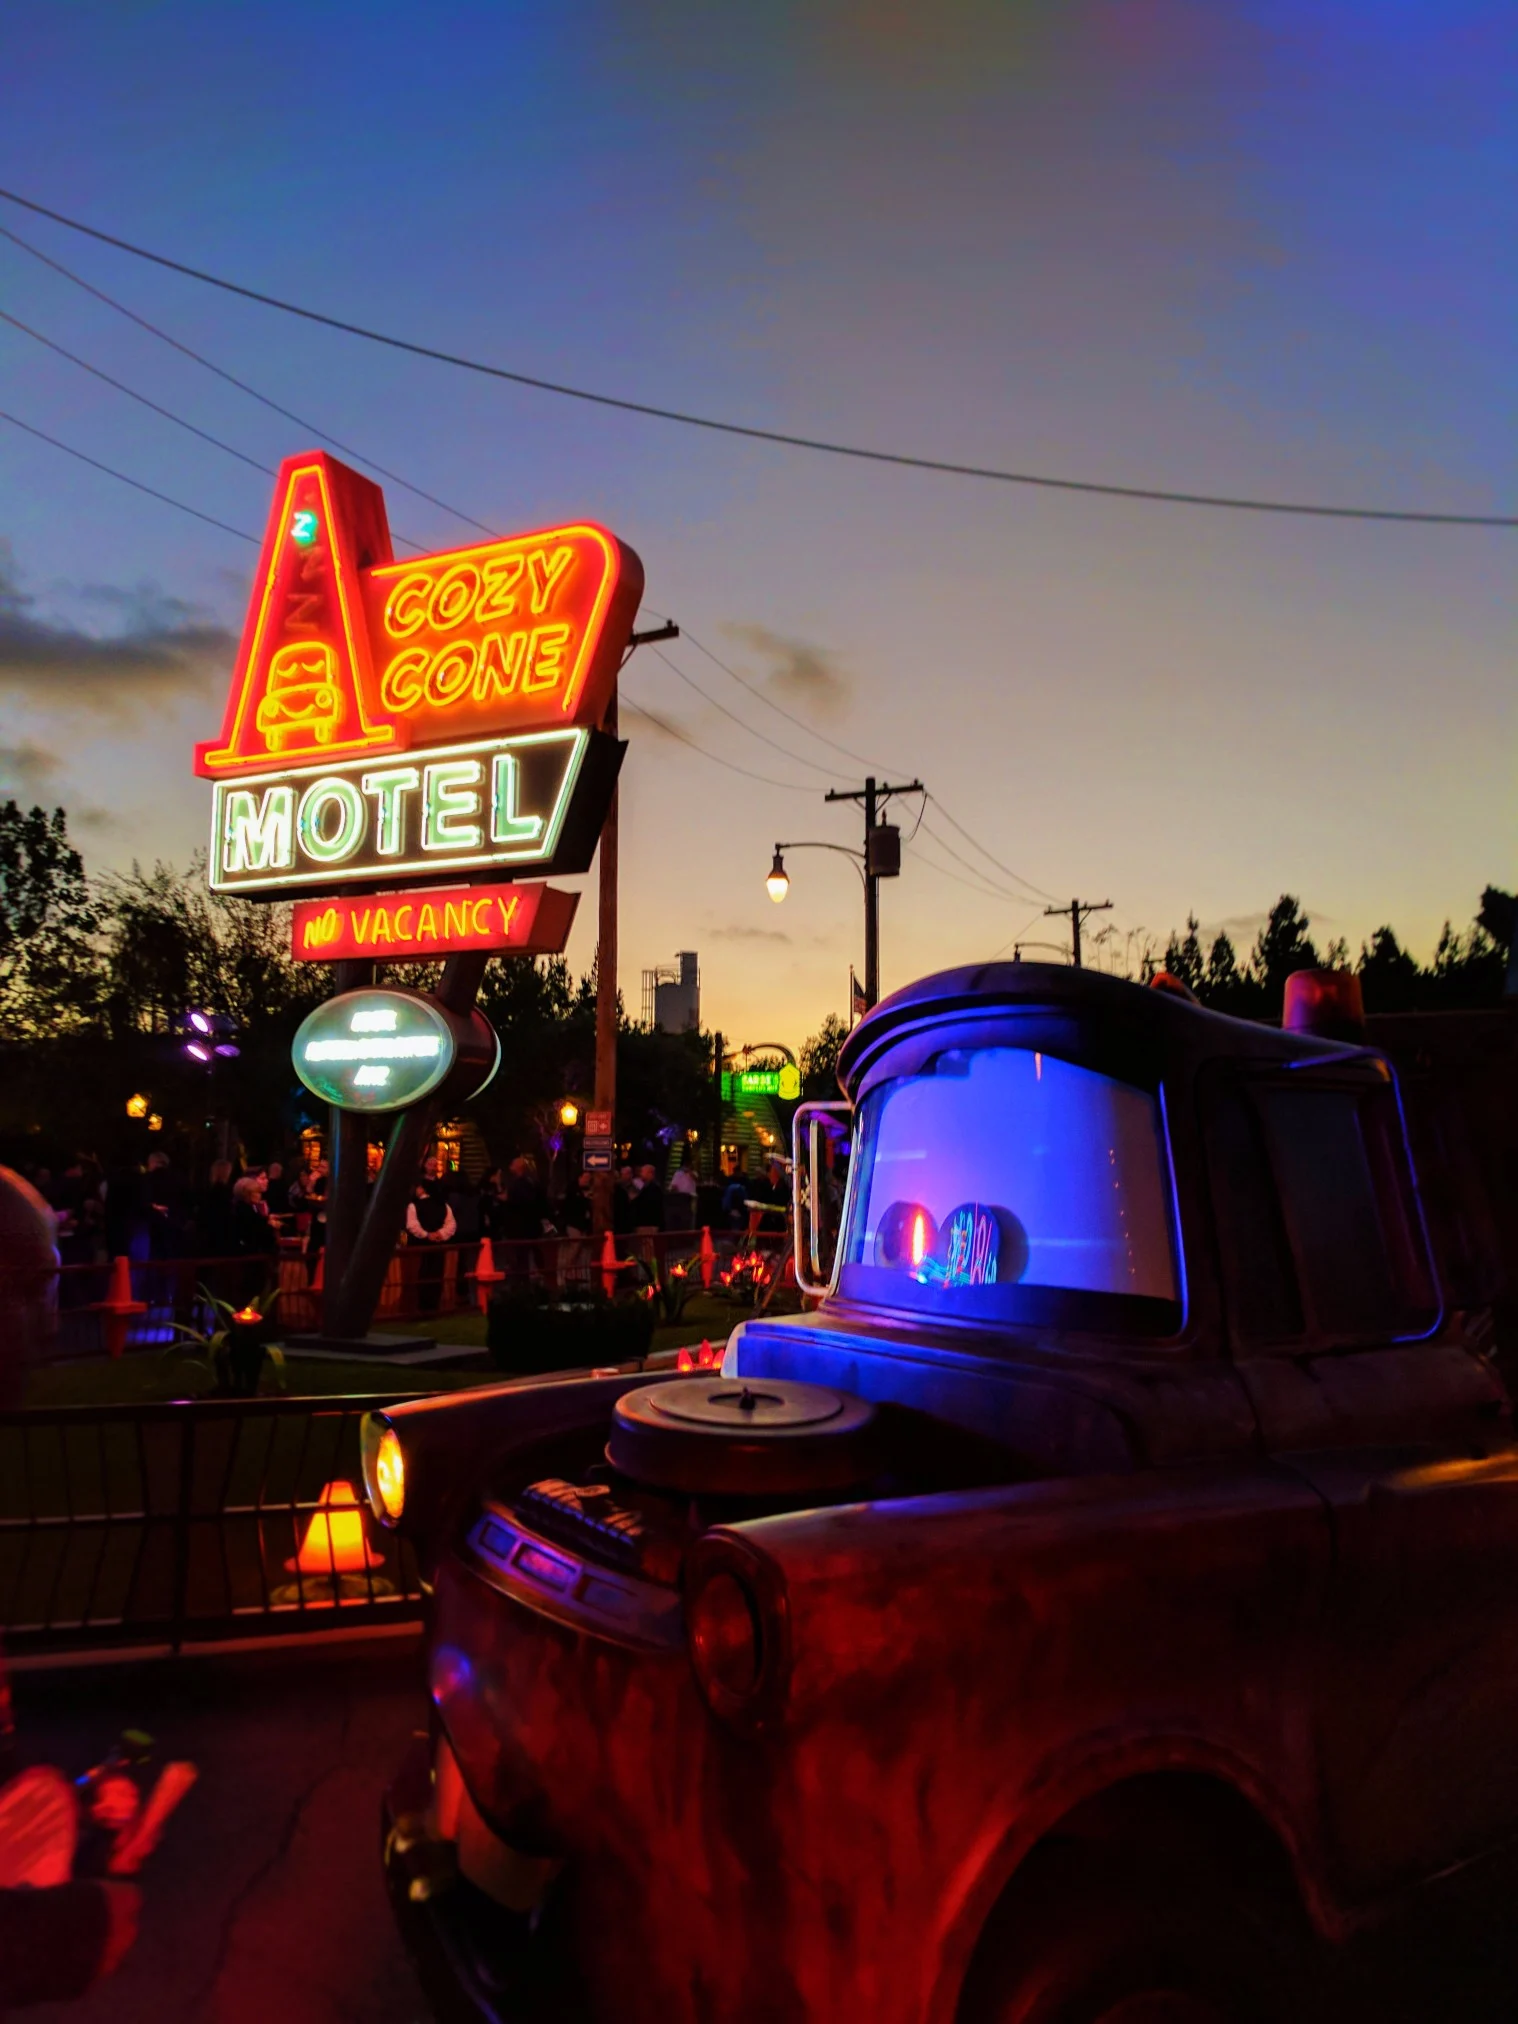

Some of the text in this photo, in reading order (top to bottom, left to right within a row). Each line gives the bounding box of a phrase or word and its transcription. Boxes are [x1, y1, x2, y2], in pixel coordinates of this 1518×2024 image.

[384, 546, 574, 639] COZY
[381, 624, 572, 713] CONE
[224, 753, 543, 873] MOTEL
[302, 896, 520, 949] NO VACANCY
